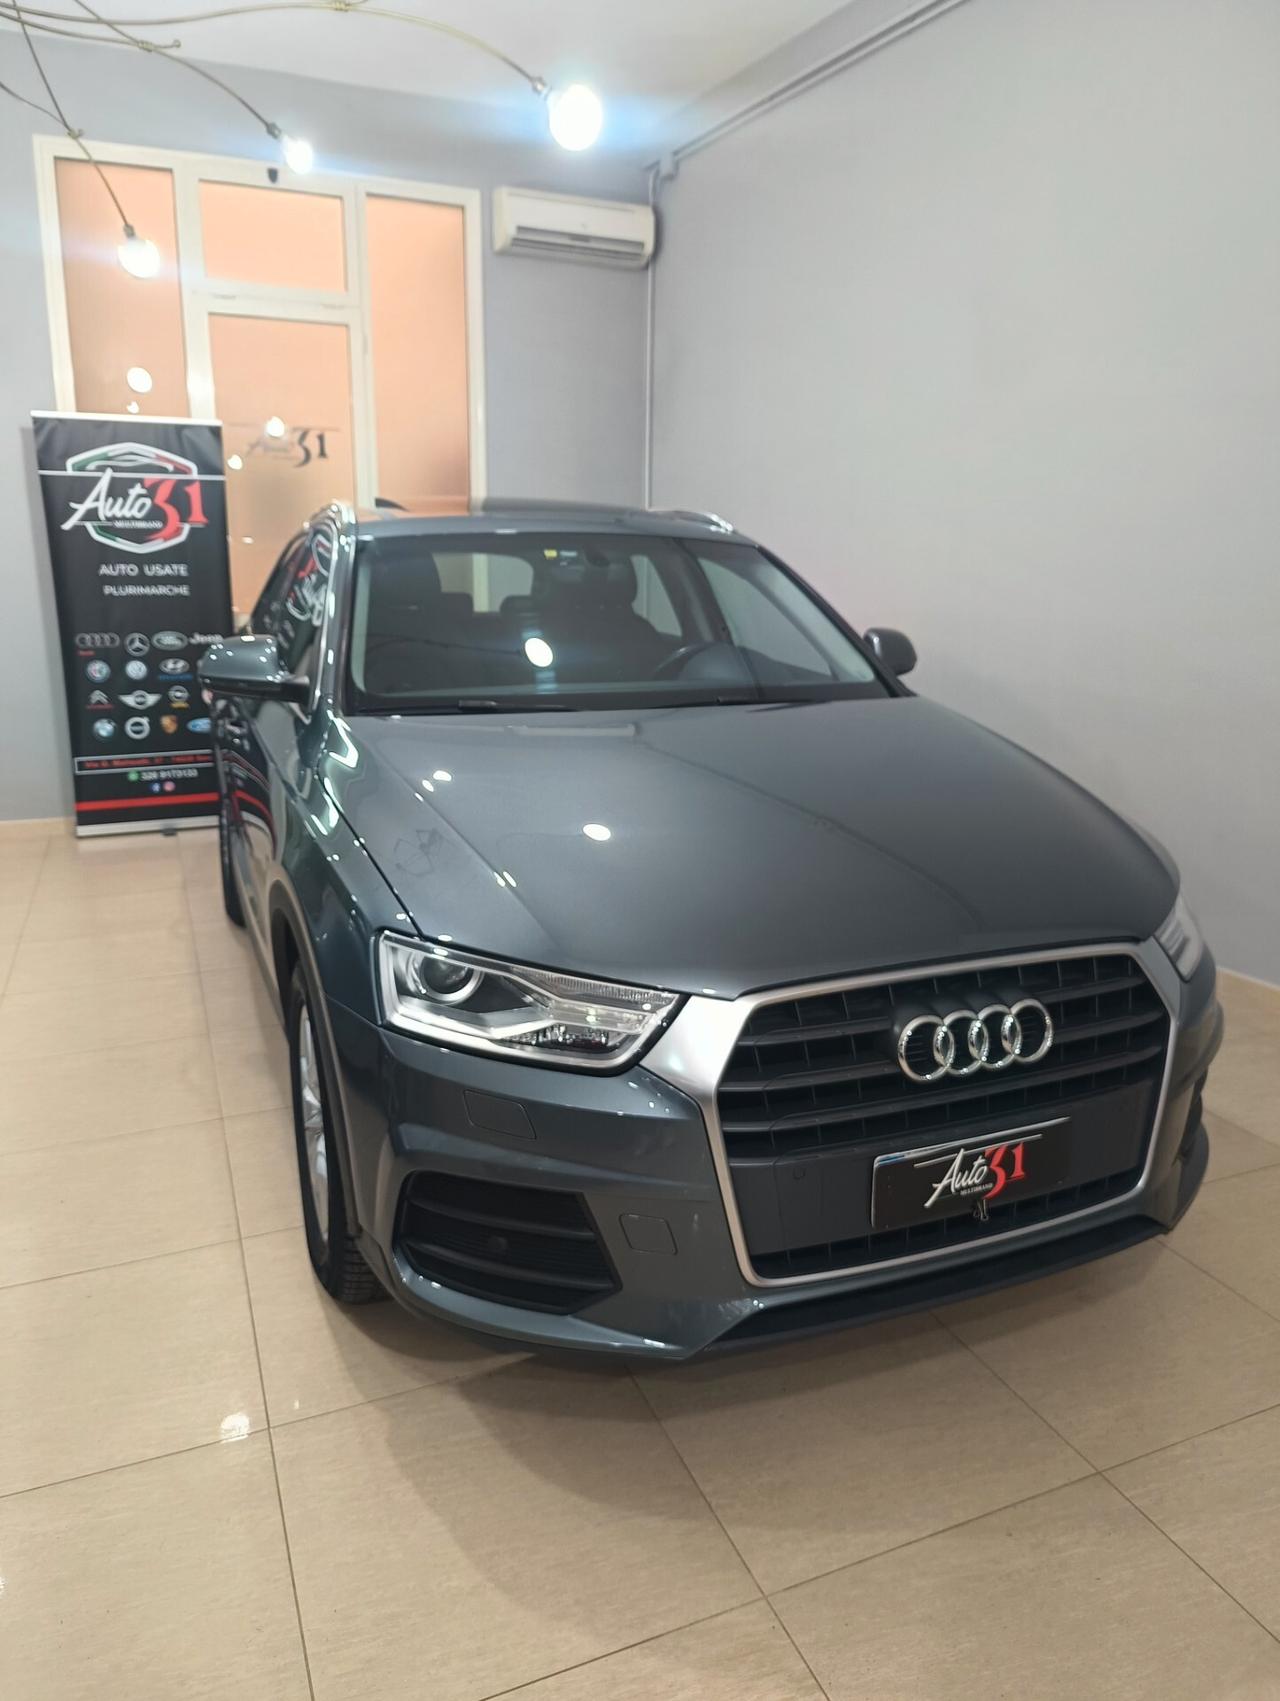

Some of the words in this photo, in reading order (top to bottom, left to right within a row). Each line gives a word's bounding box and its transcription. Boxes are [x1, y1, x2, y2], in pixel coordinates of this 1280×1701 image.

[60, 467, 152, 531] Auto
[143, 477, 208, 541] 31
[99, 563, 139, 576] AUTO
[143, 563, 188, 577] USATE
[103, 584, 190, 596] PLURIMARCHE
[923, 1148, 988, 1209] Auto
[984, 1141, 1025, 1200] 31
